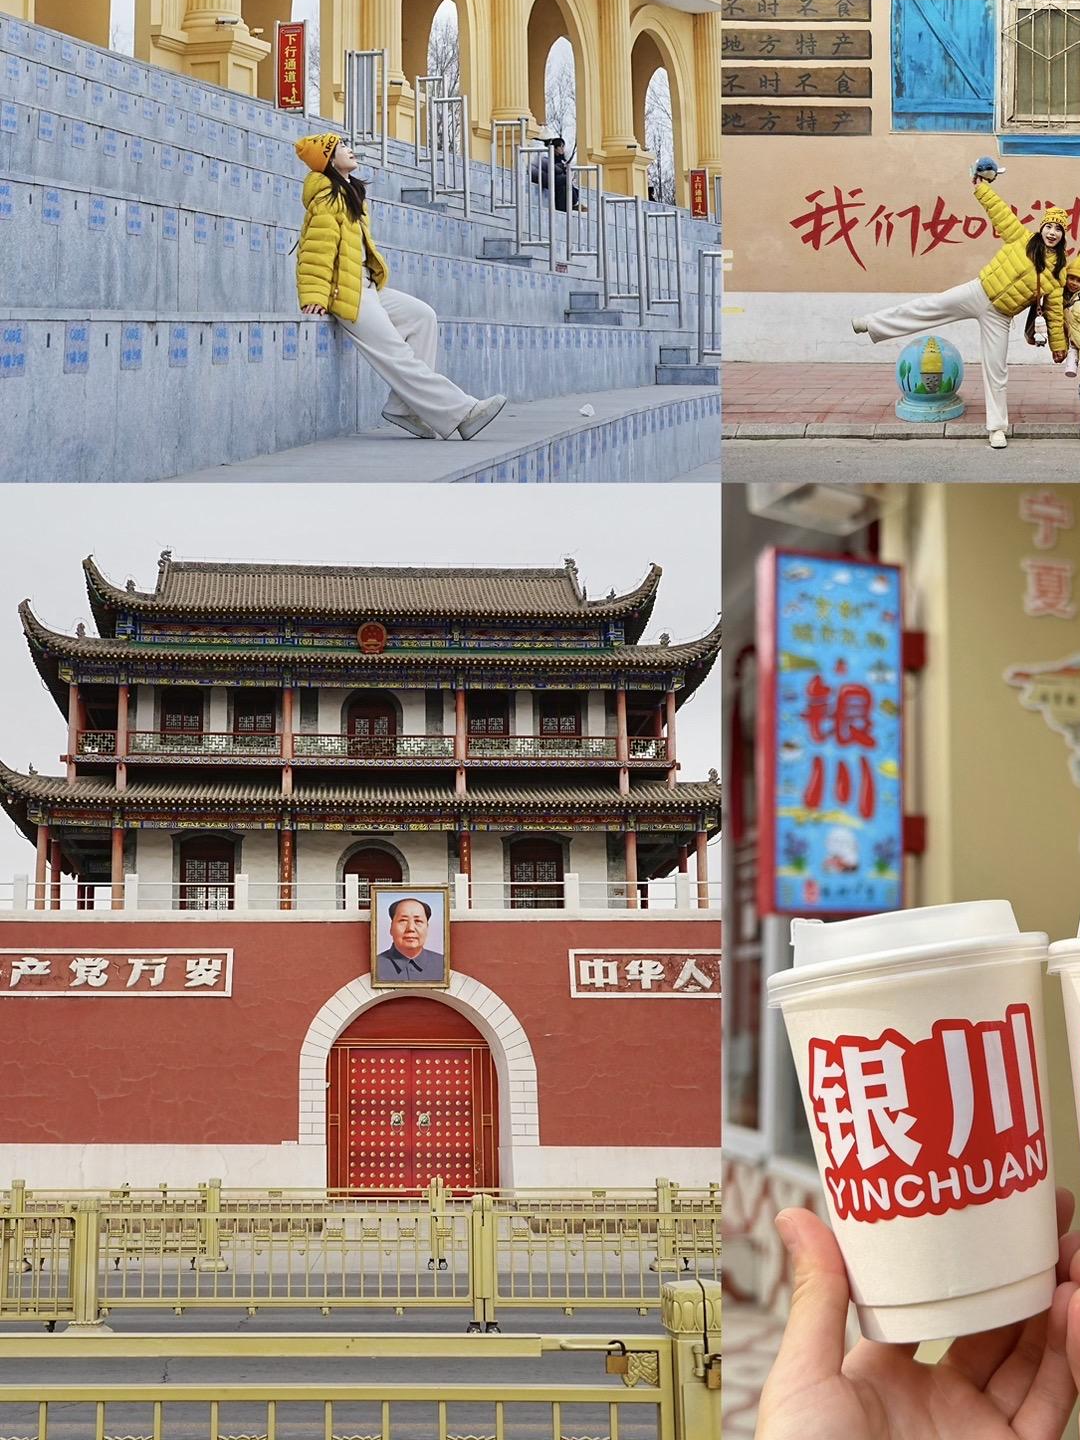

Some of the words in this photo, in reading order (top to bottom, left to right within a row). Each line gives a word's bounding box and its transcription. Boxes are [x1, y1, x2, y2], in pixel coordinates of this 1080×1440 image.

[284, 33, 298, 83] 下行通道
[722, 32, 854, 56] 地方特产
[723, 70, 856, 94] 不时不食
[722, 110, 854, 132] 地方特产
[800, 674, 877, 821] 银川
[9, 956, 222, 987] 产党万岁
[580, 958, 721, 990] 中华人
[813, 1013, 1040, 1171] 银川
[828, 1139, 1045, 1212] YINCHUAN
